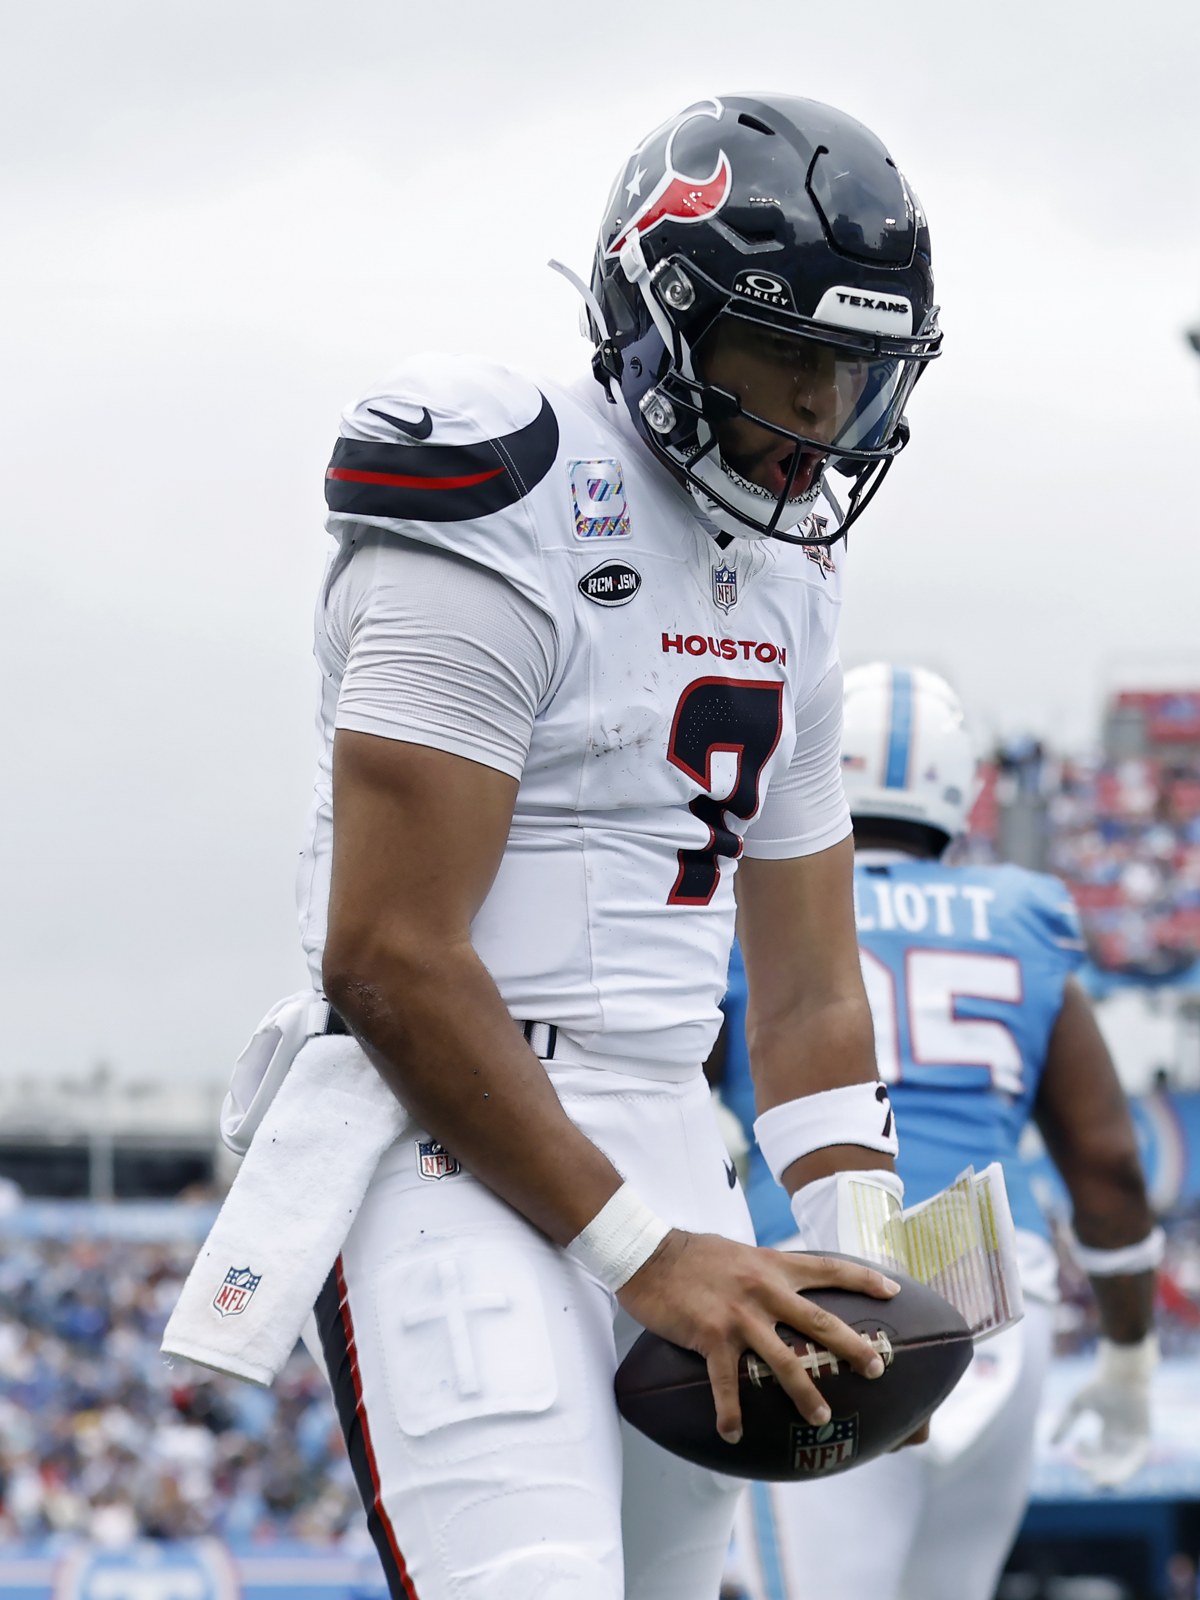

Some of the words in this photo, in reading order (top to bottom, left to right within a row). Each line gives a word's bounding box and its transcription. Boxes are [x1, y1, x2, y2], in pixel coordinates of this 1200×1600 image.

[735, 283, 788, 307] OAKLEY
[836, 292, 908, 313] TEXANS
[587, 576, 613, 594] RCM
[617, 573, 637, 590] JSM
[717, 584, 736, 604] NFL
[661, 632, 787, 667] HOUSTON
[666, 675, 785, 906] 7
[423, 1156, 454, 1175] NFL
[218, 1285, 248, 1312] NFL
[797, 1443, 852, 1471] NFL
